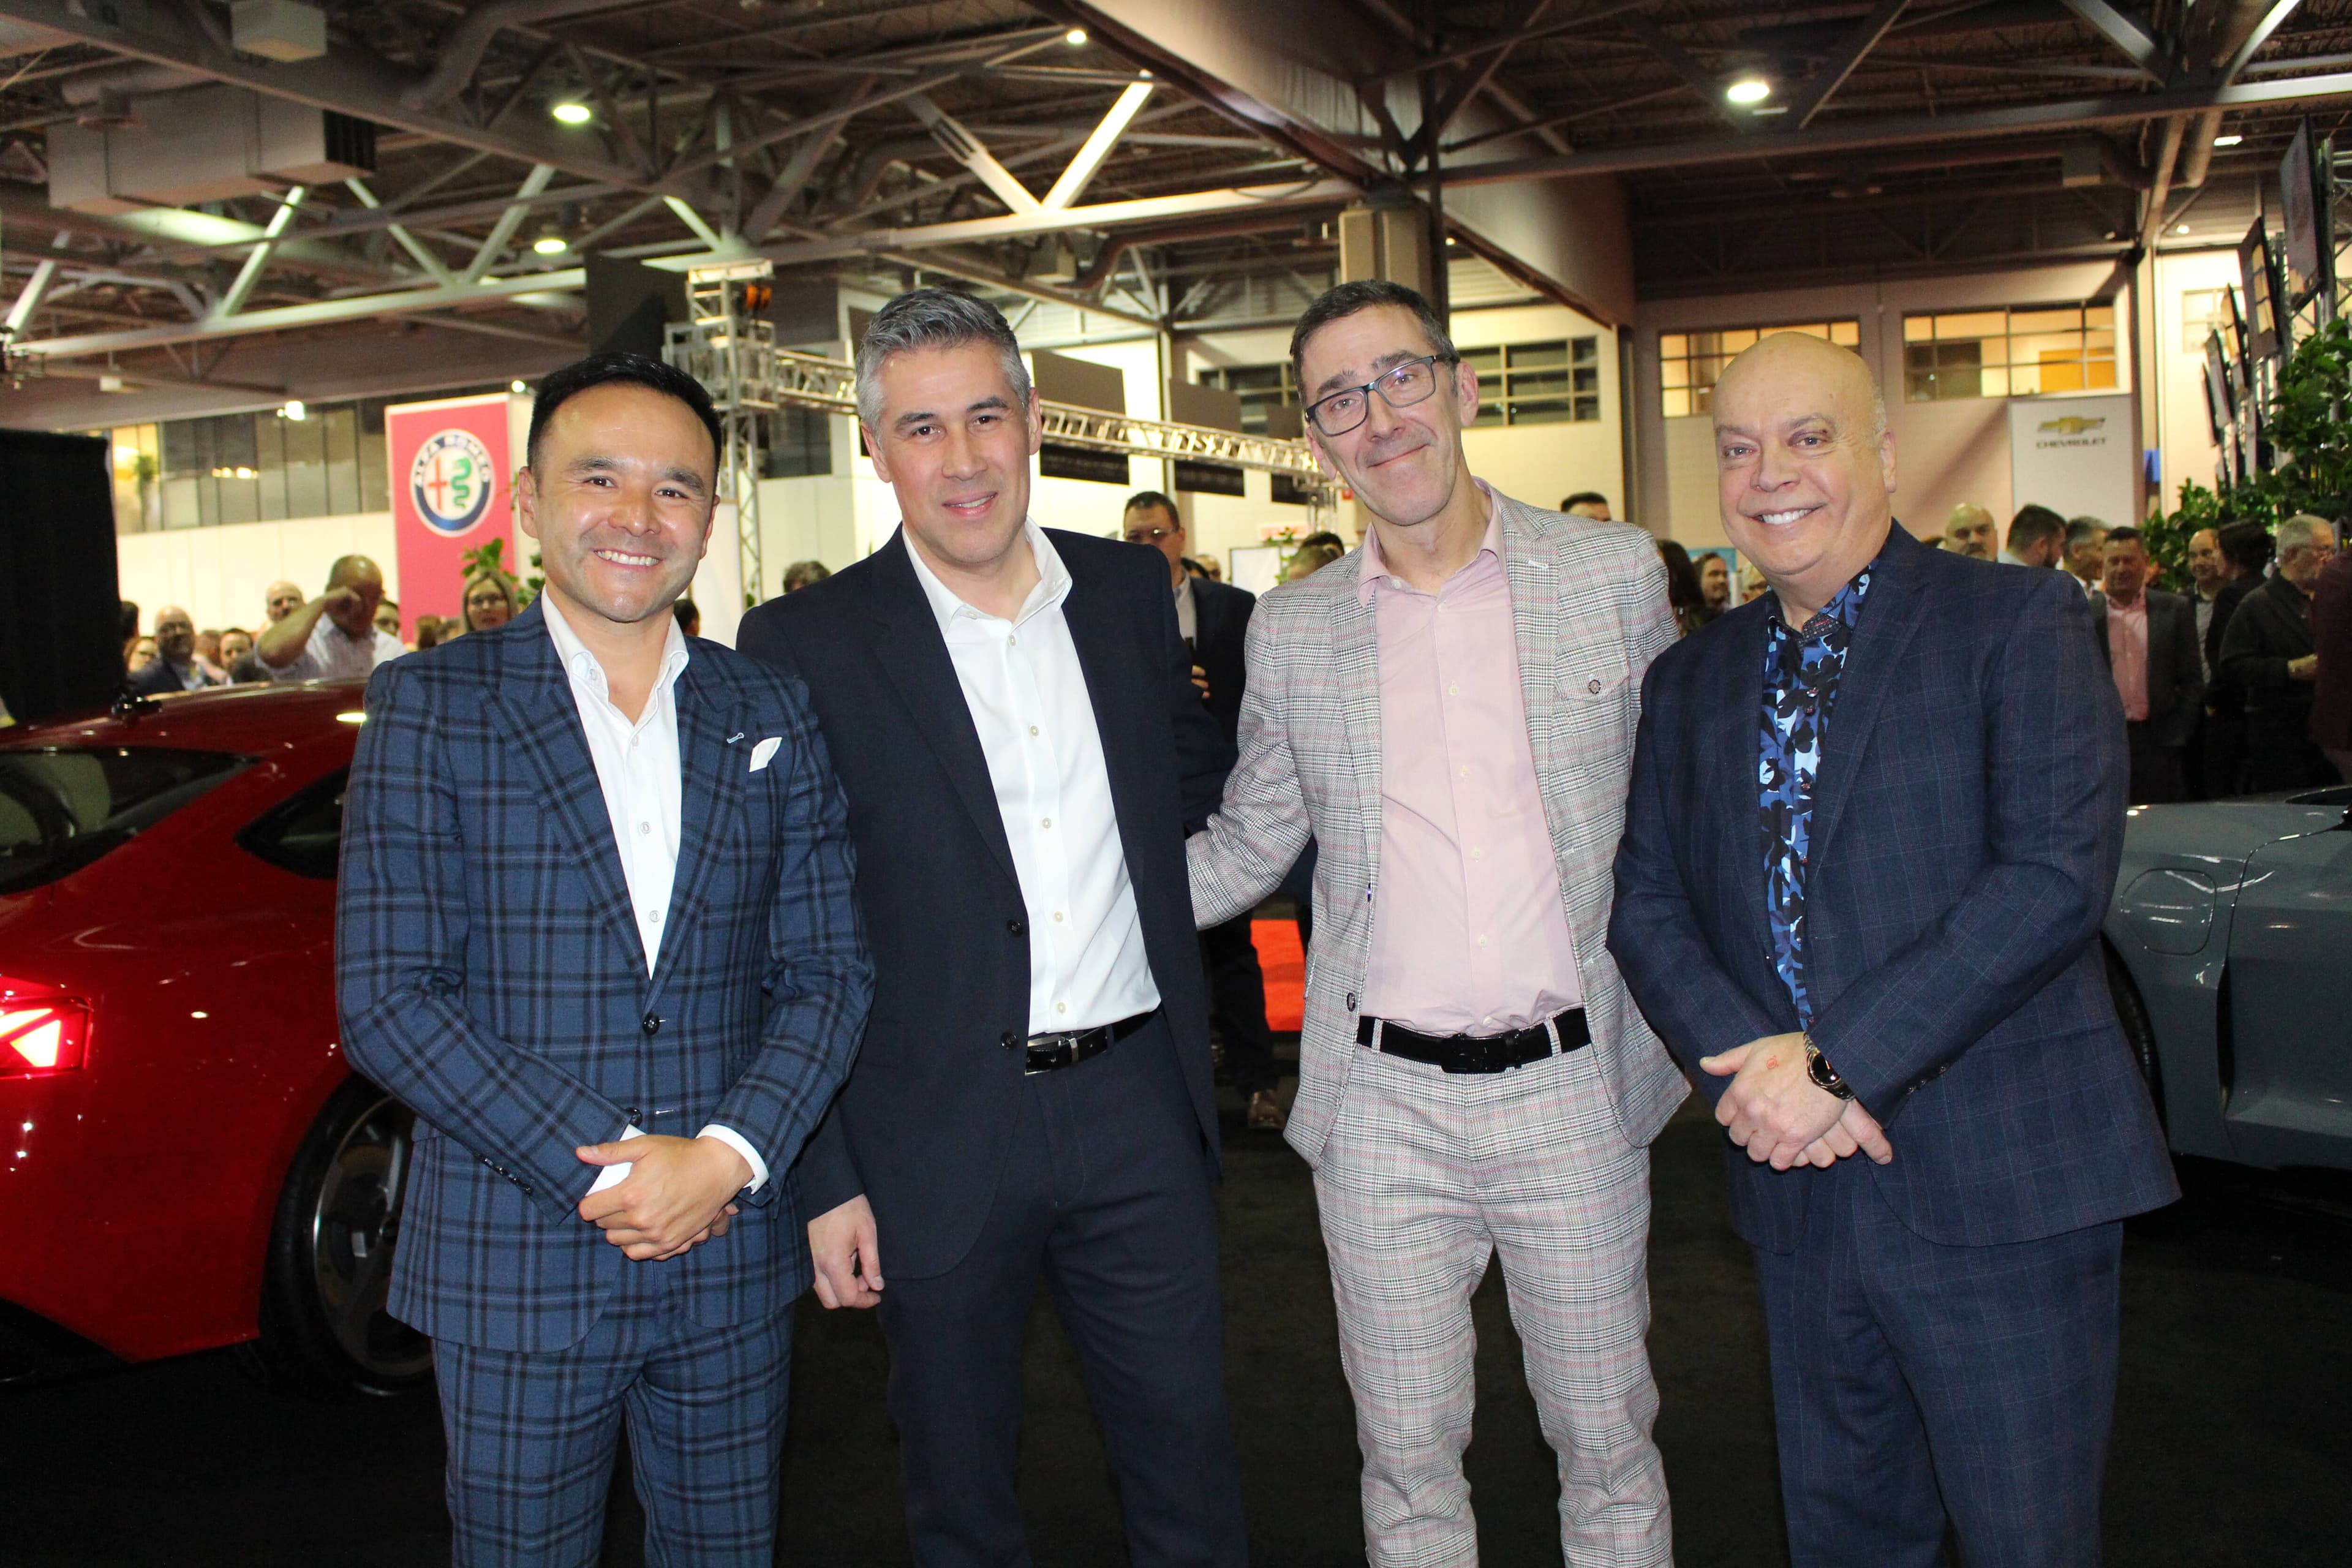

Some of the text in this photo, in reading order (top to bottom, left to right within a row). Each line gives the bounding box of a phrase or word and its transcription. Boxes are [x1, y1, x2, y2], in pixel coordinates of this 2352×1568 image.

[2036, 437, 2106, 448] CHEVROLET
[414, 434, 491, 487] ALFA ROMEO
